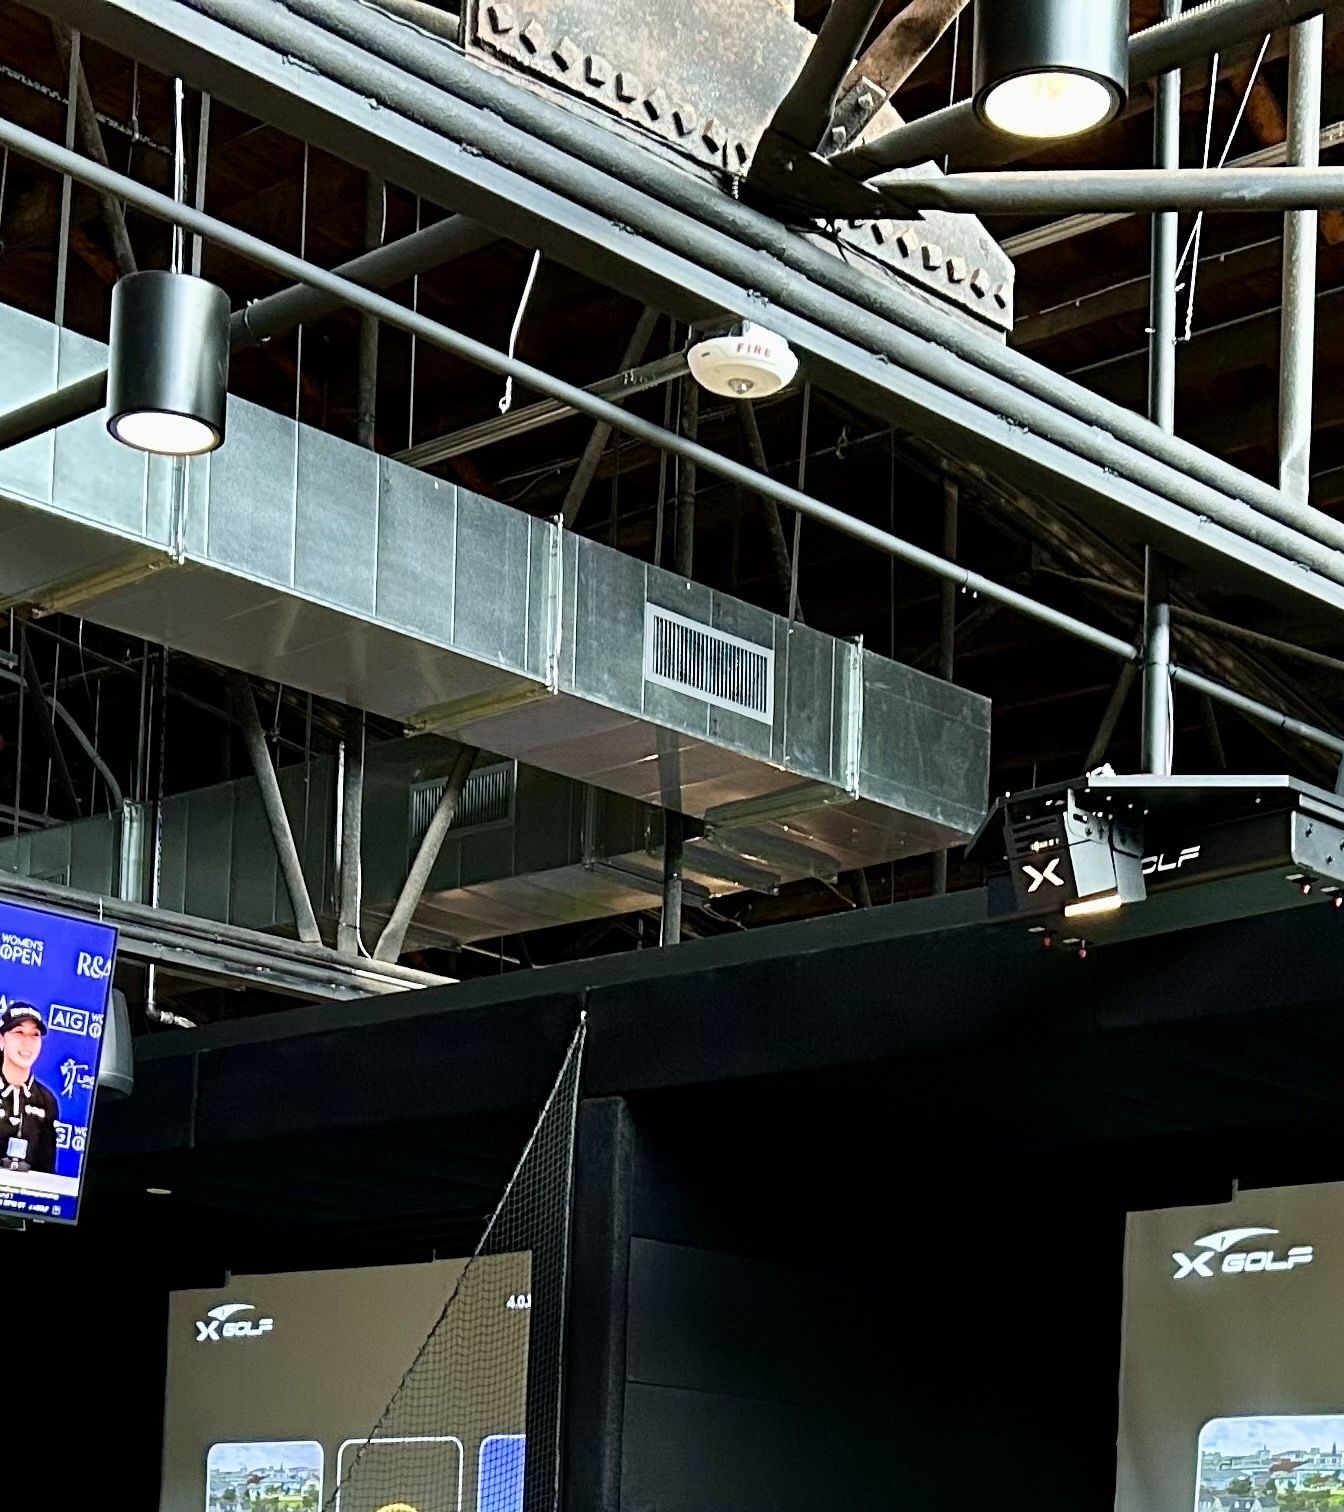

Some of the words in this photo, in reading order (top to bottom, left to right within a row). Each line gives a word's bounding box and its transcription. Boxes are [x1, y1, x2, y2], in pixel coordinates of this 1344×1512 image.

[736, 342, 771, 358] FIRE
[1022, 857, 1065, 893] X
[1141, 845, 1201, 875] OLF
[1, 934, 44, 952] WOMEN'S
[0, 944, 43, 968] OPEN
[52, 1010, 84, 1031] AIG
[1171, 1251, 1215, 1279] X
[1221, 1245, 1313, 1273] GOLF
[195, 1320, 220, 1342] X
[222, 1317, 273, 1337] GOLF
